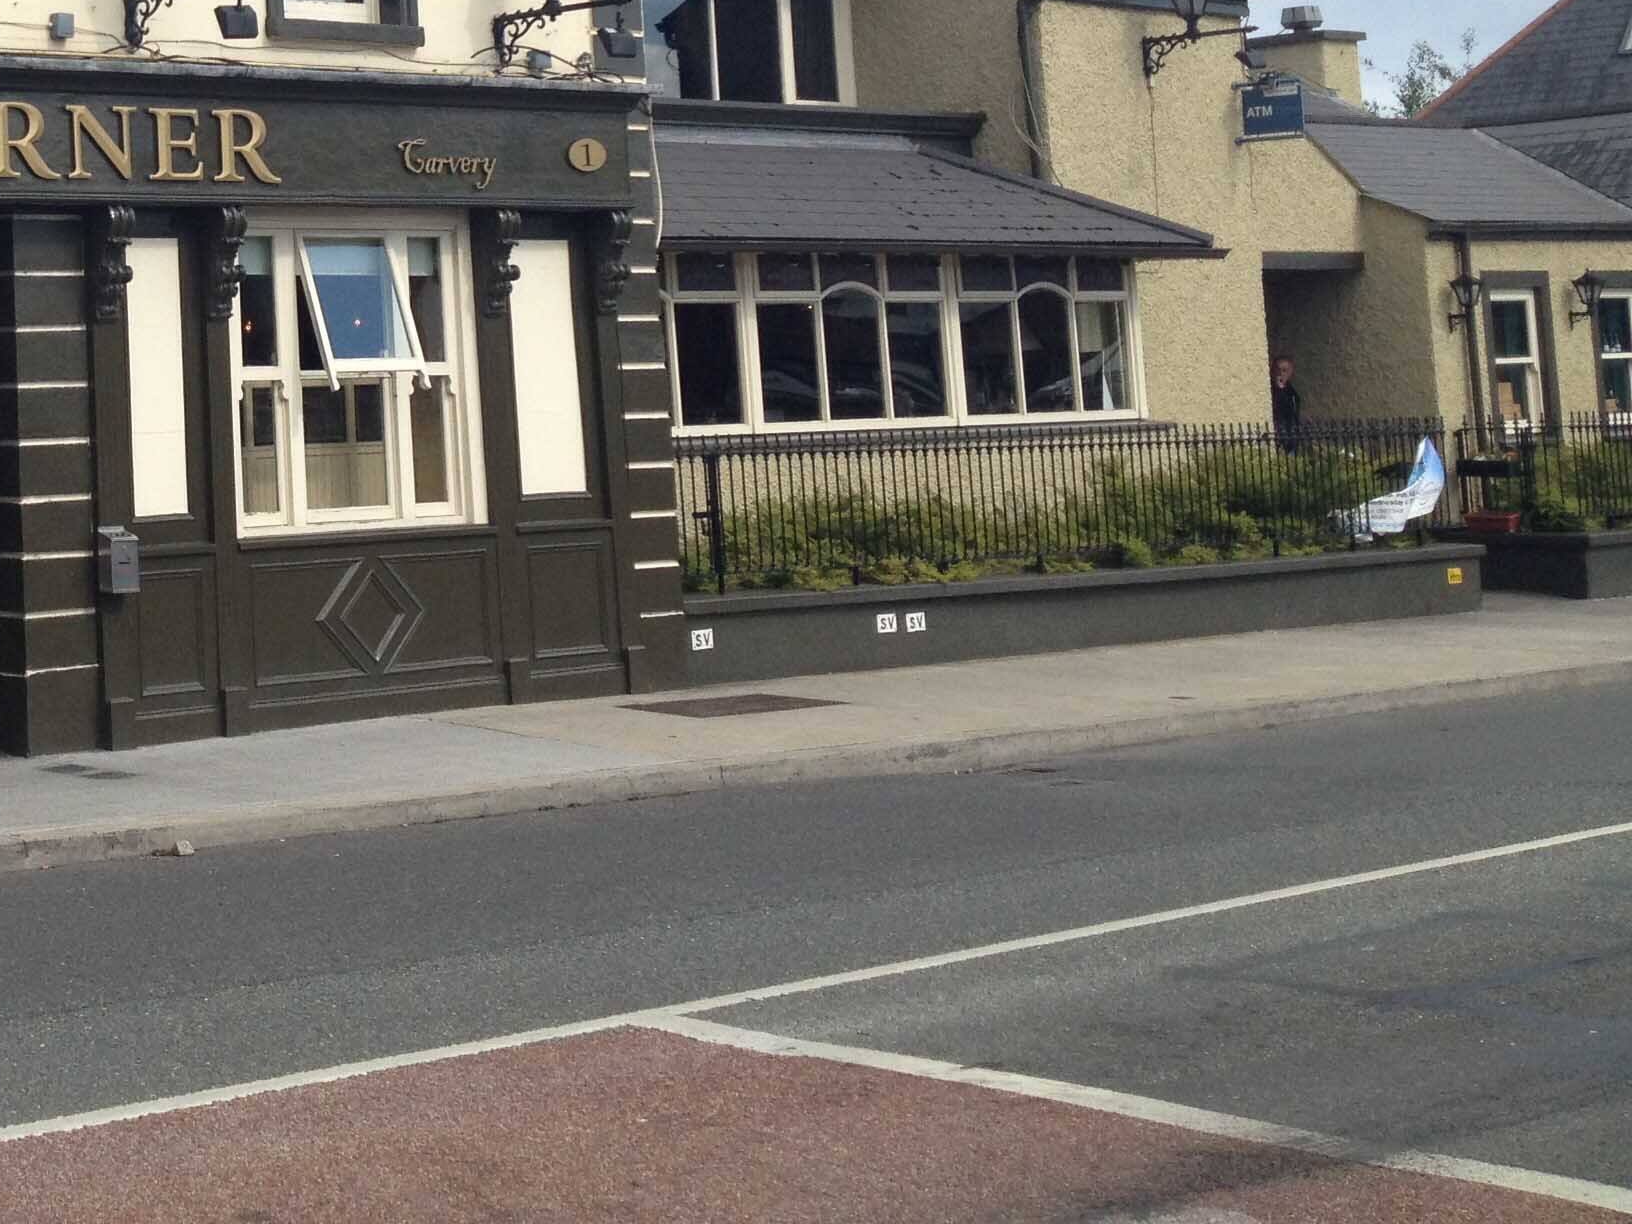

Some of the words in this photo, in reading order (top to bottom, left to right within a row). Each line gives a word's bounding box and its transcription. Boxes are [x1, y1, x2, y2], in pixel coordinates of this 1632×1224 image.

[1246, 105, 1273, 118] ATM
[581, 143, 593, 167] 1
[398, 138, 496, 189] Carvery
[880, 616, 896, 630] SV
[909, 615, 924, 629] SV
[695, 632, 710, 648] SV
